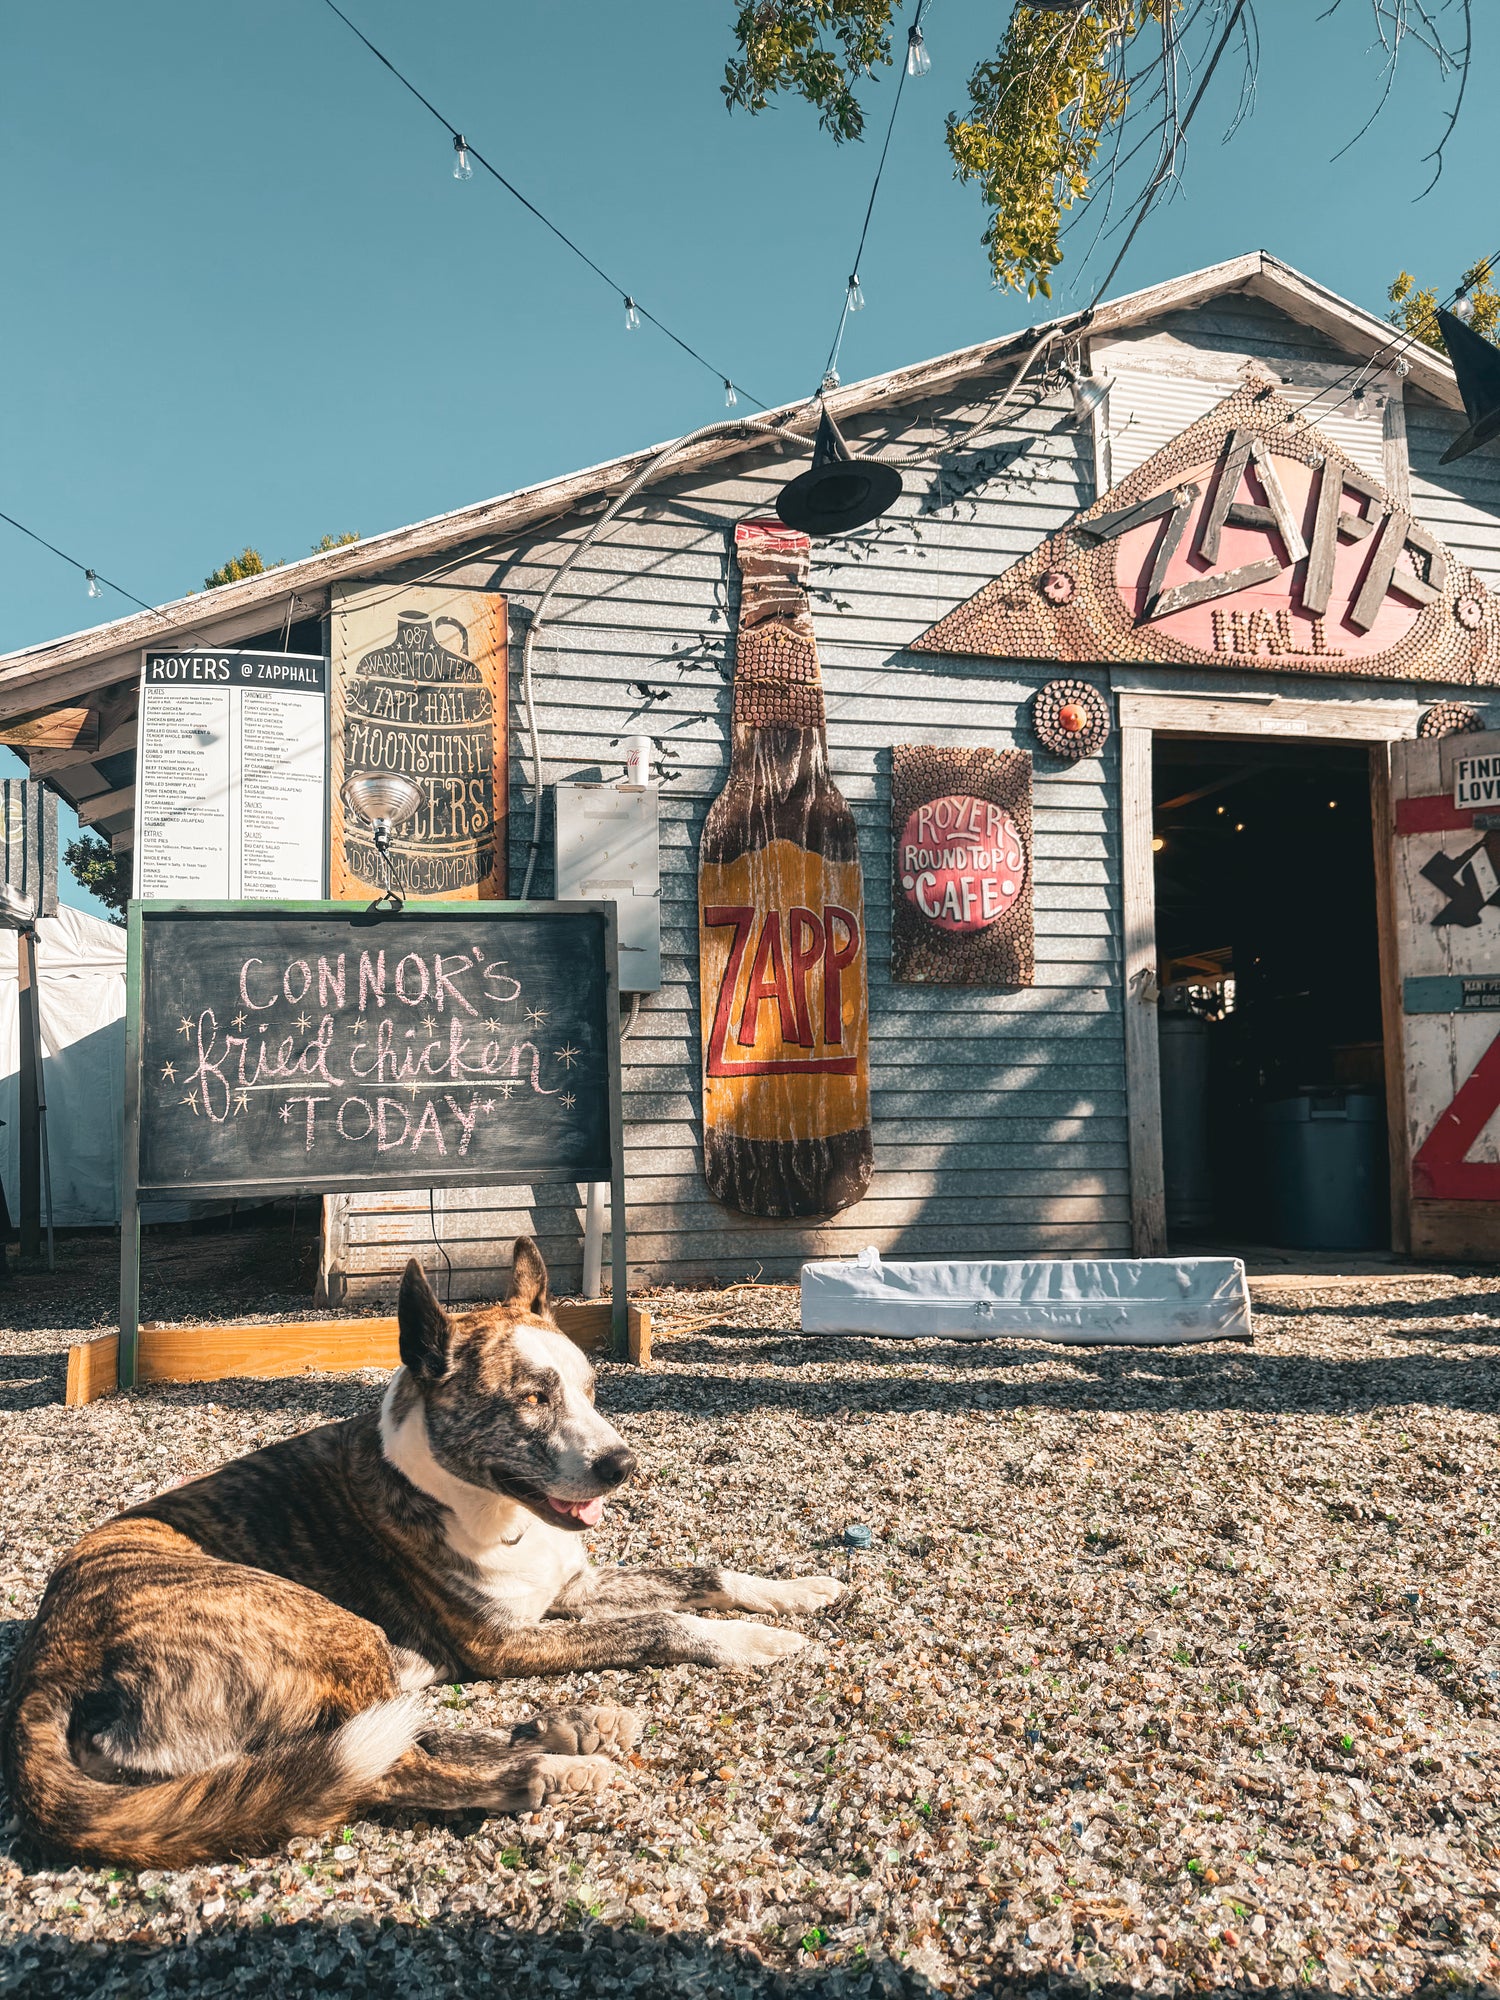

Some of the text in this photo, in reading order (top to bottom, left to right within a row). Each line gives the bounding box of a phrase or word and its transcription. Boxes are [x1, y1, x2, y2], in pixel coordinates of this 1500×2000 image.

[1077, 428, 1446, 631] ZAPP
[402, 626, 428, 649] 1987
[1212, 608, 1346, 656] HALL
[152, 658, 319, 683] ROYERS @ ZAPPHALL
[447, 657, 478, 681] TEXAS
[371, 686, 470, 723] ZAPP HALL
[350, 723, 490, 774] MOONSHINE
[244, 831, 262, 839] SALADS
[428, 856, 489, 890] COMPANY
[915, 871, 1003, 922] CAFE
[239, 946, 522, 1016] CONNOR'S
[704, 905, 861, 1077] ZAPP
[184, 1007, 561, 1124] fried chicken
[287, 1093, 481, 1156] TODAY
